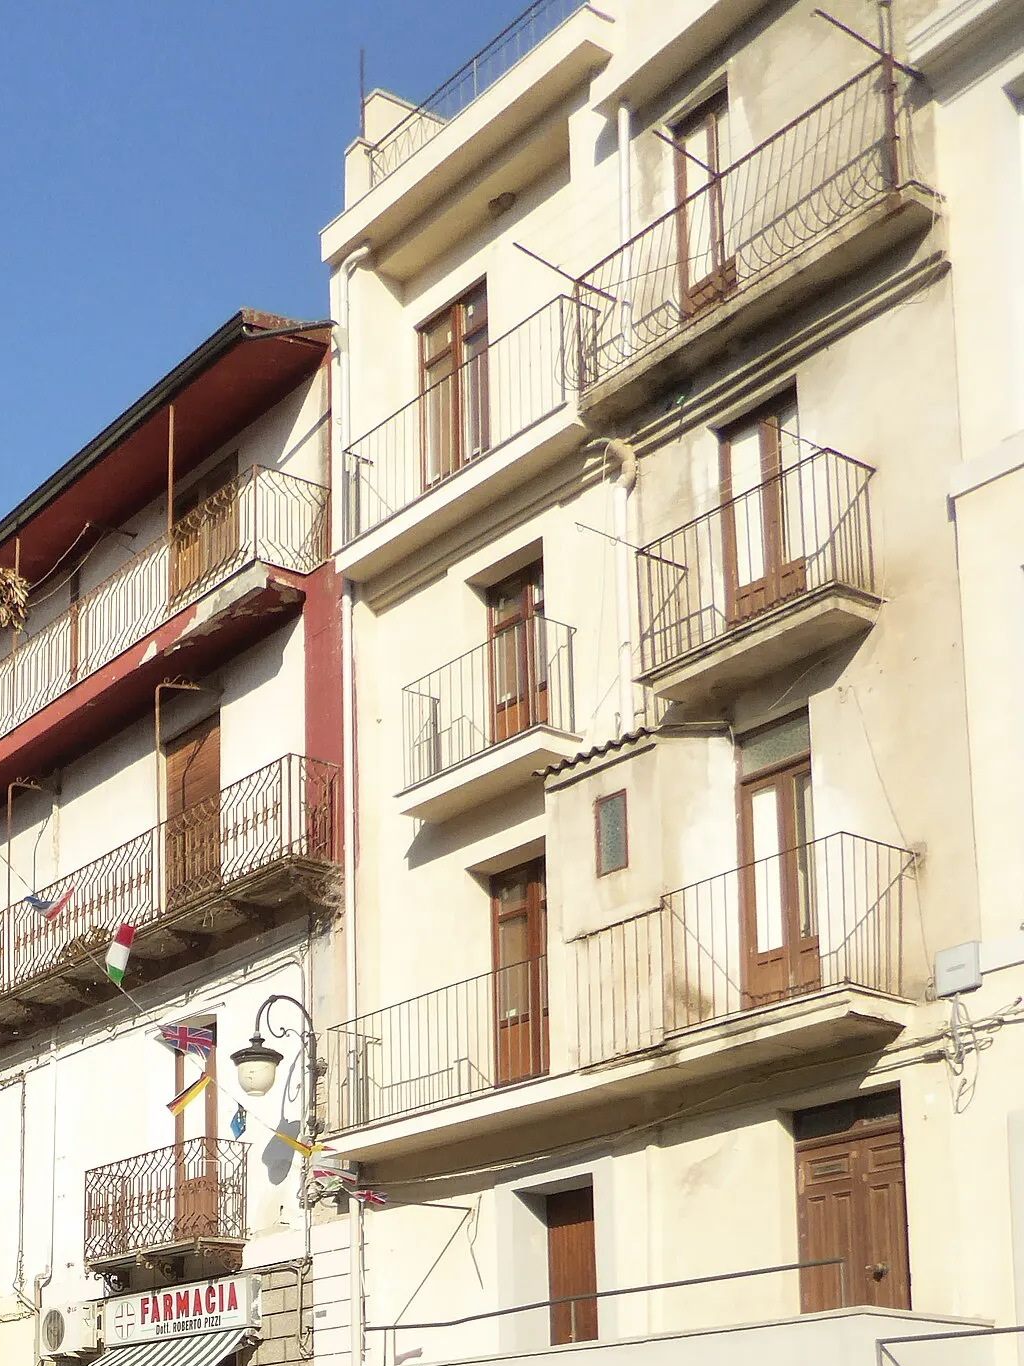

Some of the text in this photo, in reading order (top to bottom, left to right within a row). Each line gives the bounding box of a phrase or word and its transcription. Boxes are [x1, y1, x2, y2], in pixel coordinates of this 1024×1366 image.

[140, 1281, 238, 1325] FARMACIA
[156, 1315, 221, 1335] Dott. ROBERTO PIZZI
